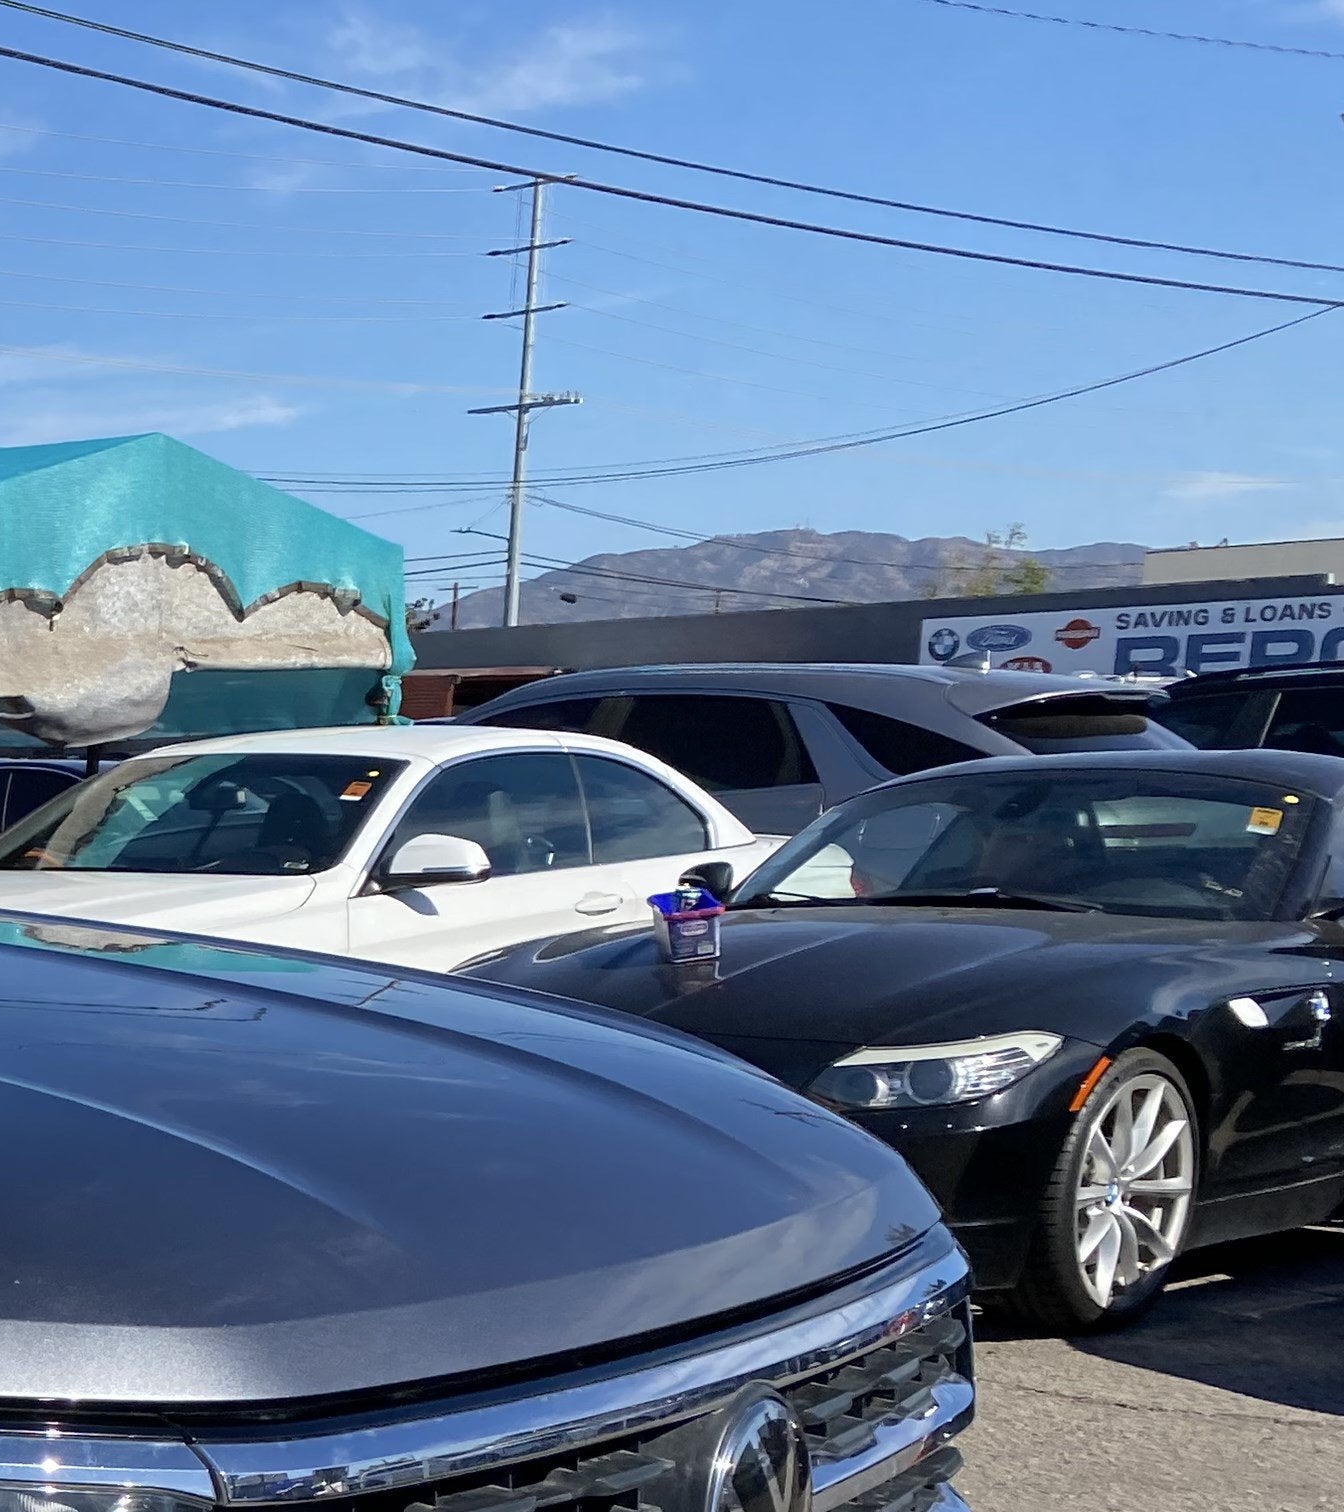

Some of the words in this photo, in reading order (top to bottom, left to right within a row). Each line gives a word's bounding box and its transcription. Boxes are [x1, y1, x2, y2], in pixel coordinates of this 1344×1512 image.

[1115, 608, 1210, 630] SAVING
[1220, 606, 1236, 624] &
[1244, 602, 1333, 623] LOANS
